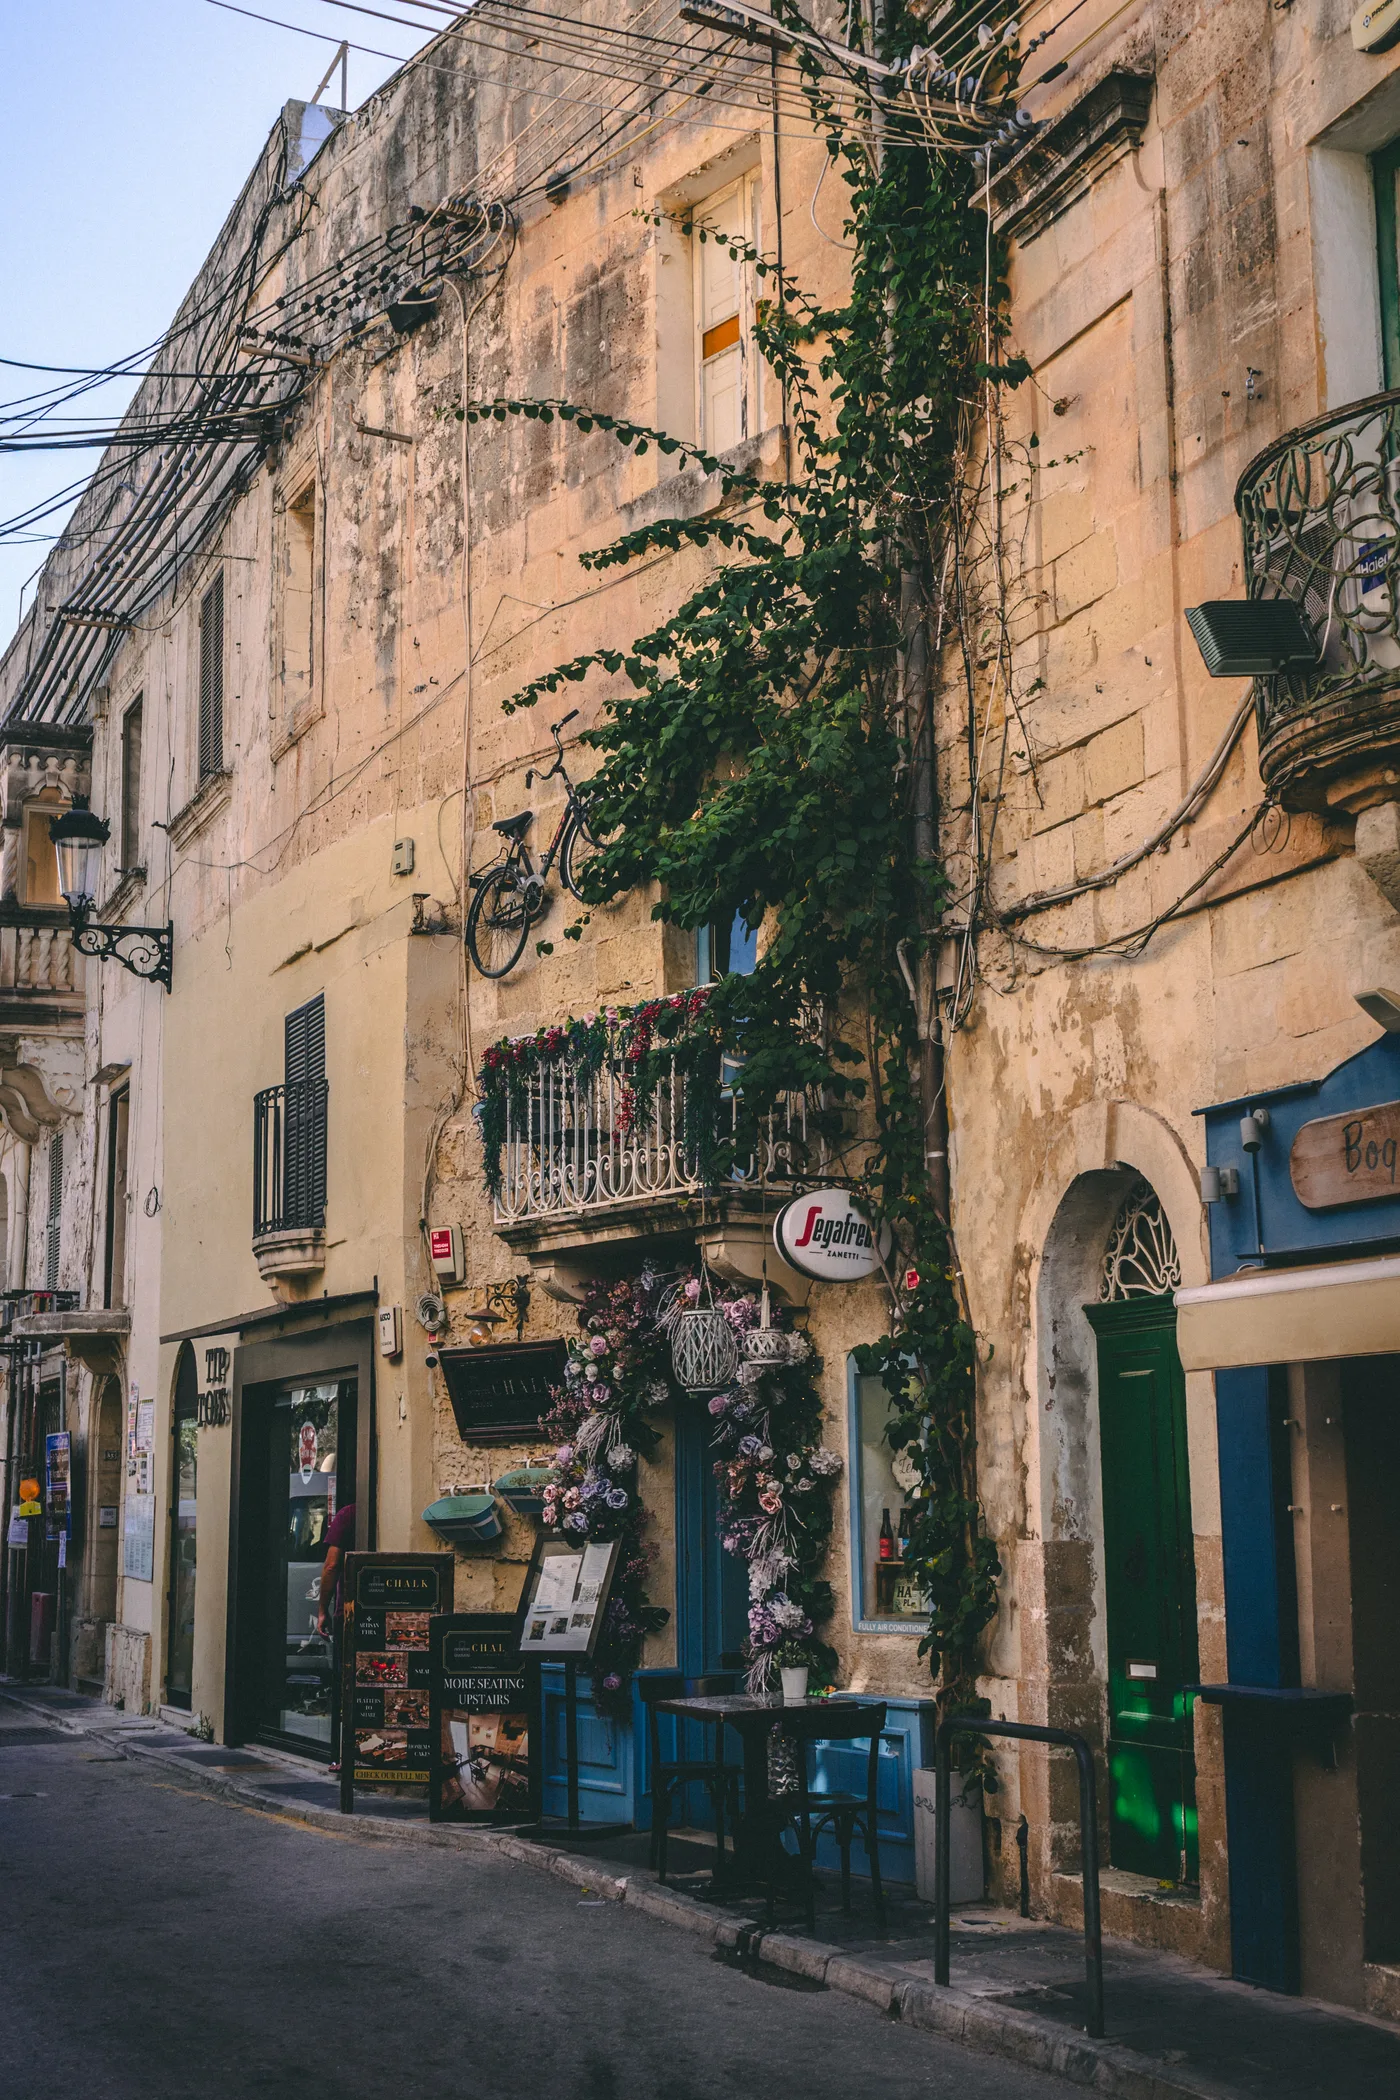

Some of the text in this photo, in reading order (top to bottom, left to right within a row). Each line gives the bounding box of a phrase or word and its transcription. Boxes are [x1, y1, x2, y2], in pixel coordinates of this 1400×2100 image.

[1361, 554, 1387, 573] Haier
[827, 1250, 859, 1260] ZANETTI
[206, 1347, 230, 1383] TIP
[198, 1387, 231, 1427] TOES
[386, 1579, 428, 1588] CHALK
[858, 1622, 877, 1631] FULLY
[878, 1623, 888, 1631] AIR
[444, 1678, 525, 1689] MORE SEATING
[459, 1694, 510, 1705] UPSTAIRS
[355, 1770, 379, 1779] CHECK
[380, 1771, 396, 1779] OUR
[396, 1772, 413, 1780] FULL
